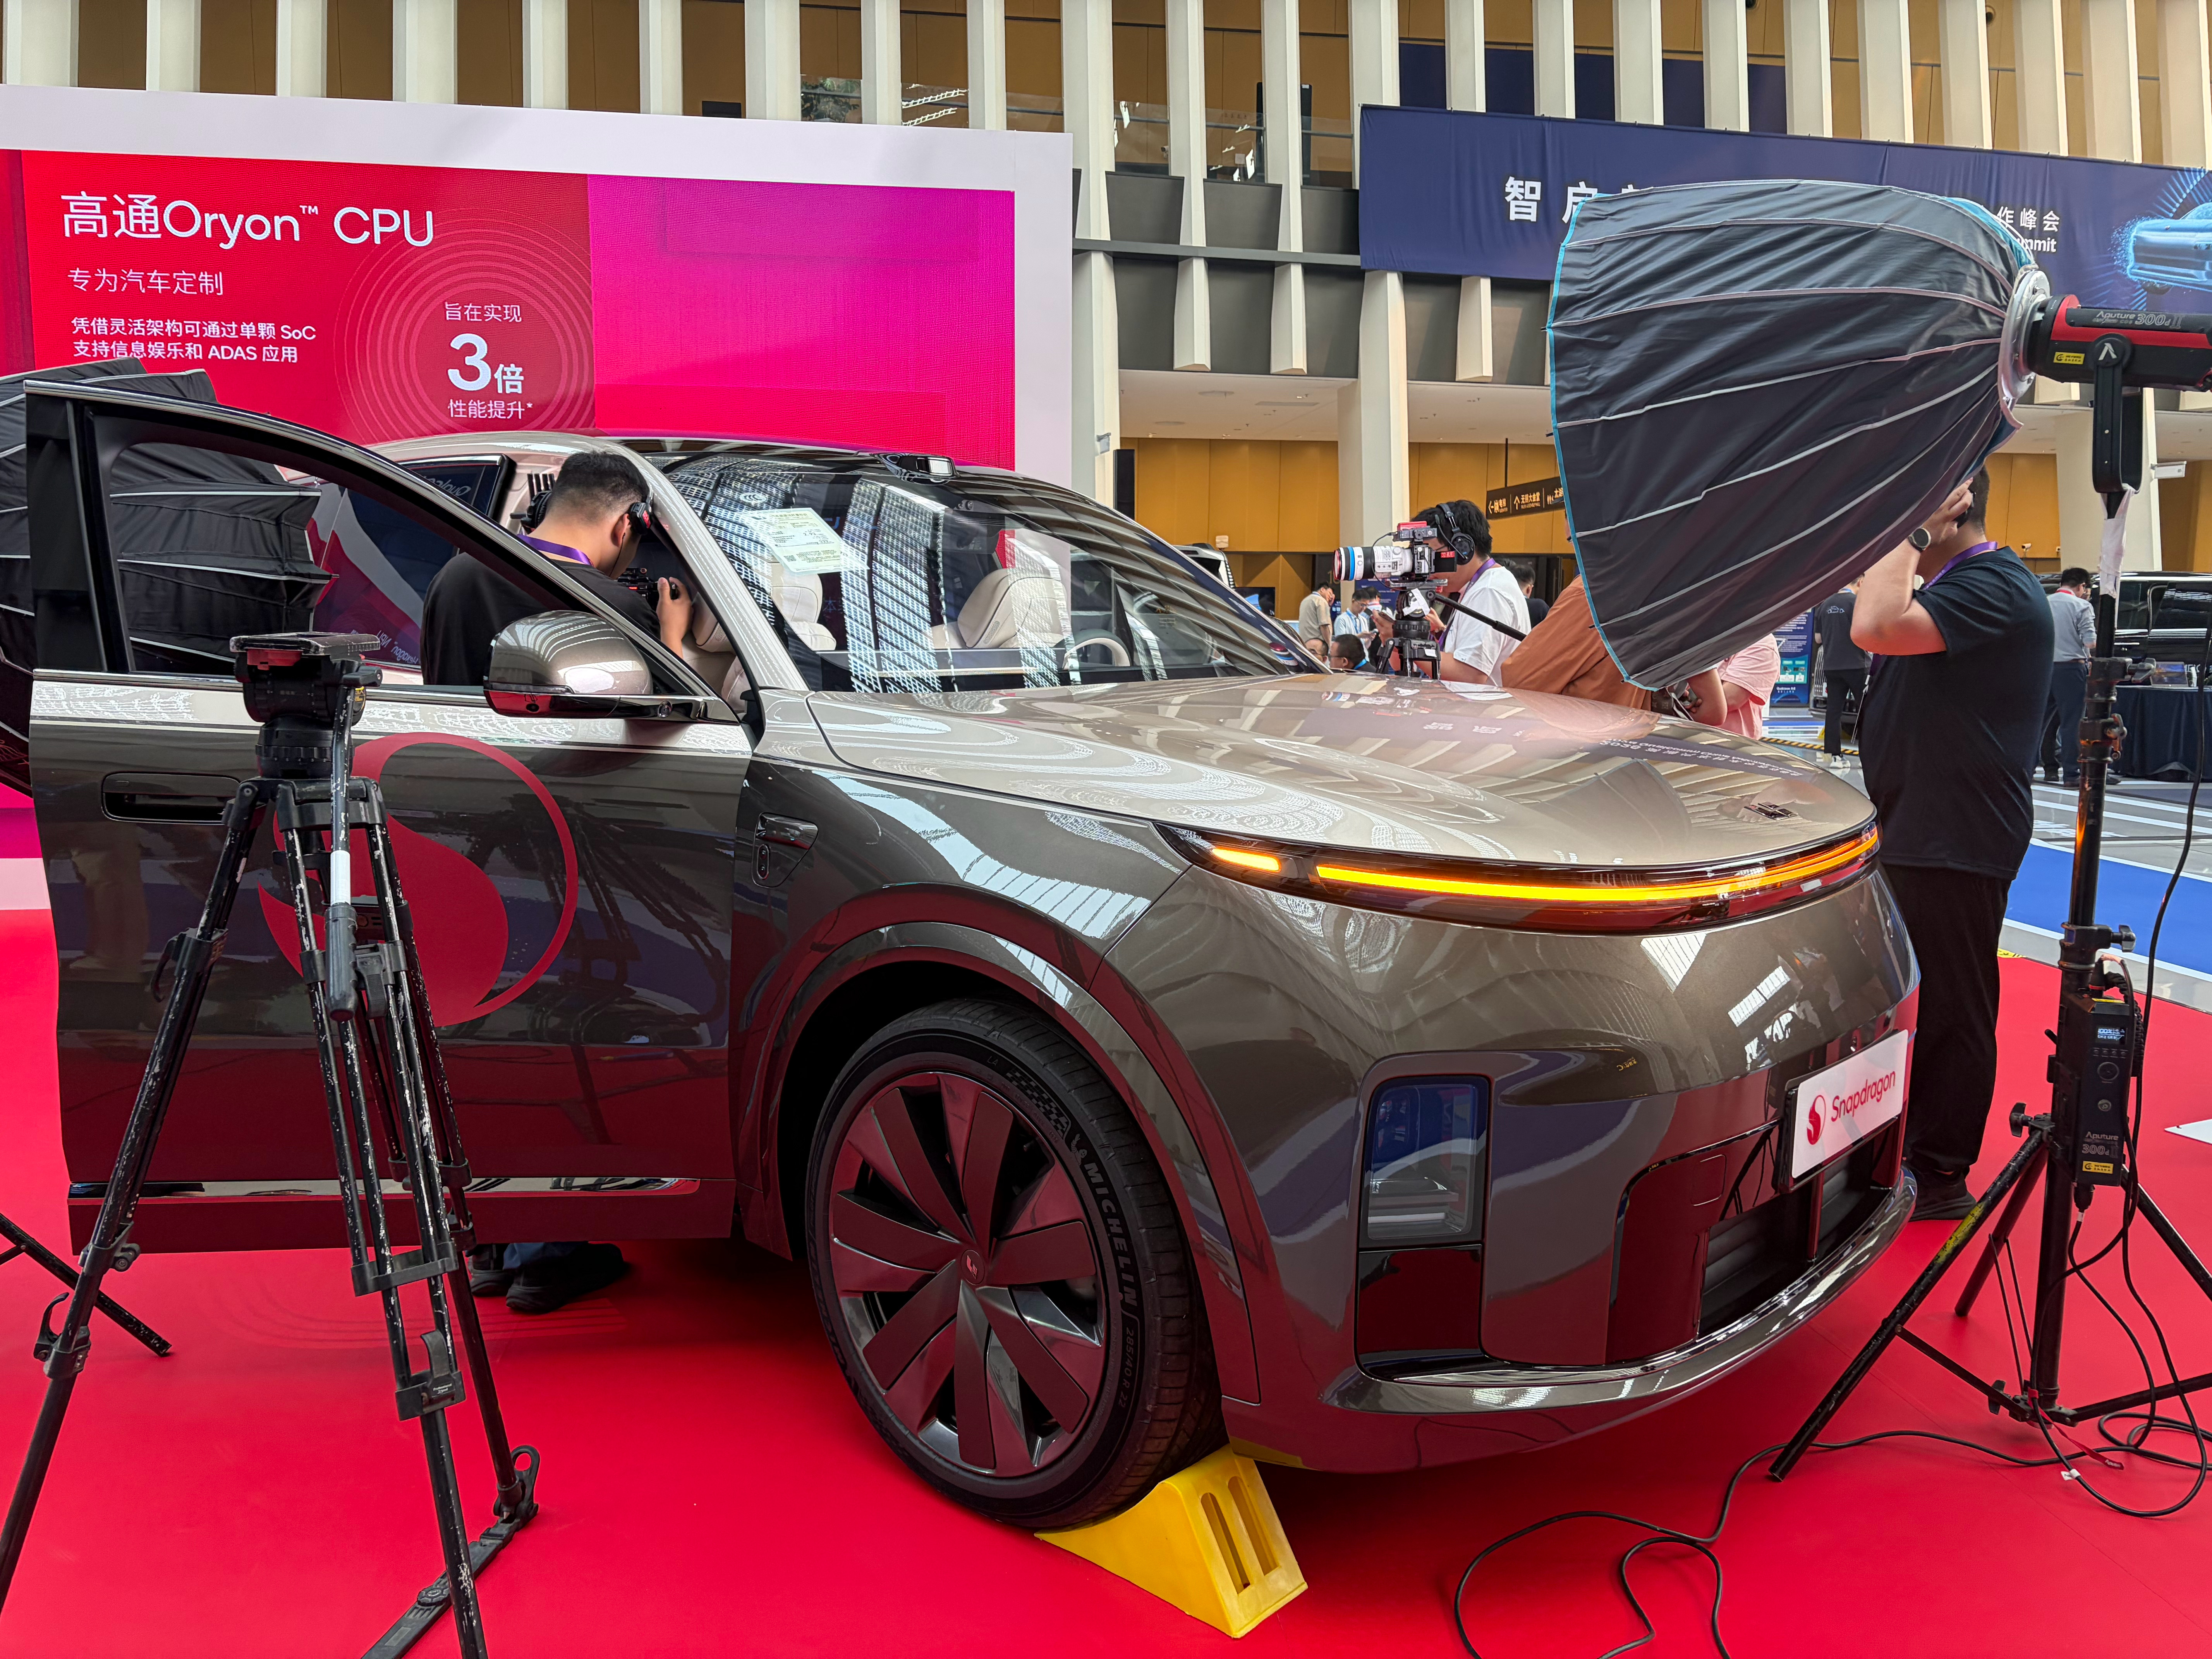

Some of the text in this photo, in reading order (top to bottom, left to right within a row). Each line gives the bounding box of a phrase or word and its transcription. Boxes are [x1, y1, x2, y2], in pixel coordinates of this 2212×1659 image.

[333, 206, 434, 247] CPU
[68, 268, 223, 295] 专为汽车定制
[444, 301, 522, 322] 旨在实现
[2096, 311, 2136, 319] Aputure
[71, 317, 316, 340] 凭借灵活架构可通过单颗 SoC
[73, 339, 298, 363] 支持信息娱乐和 ADAS 应用
[447, 333, 524, 394] 3倍
[987, 1056, 999, 1066] LA
[1831, 1071, 1896, 1122] Snapdragon
[2085, 1131, 2119, 1140] Aputure
[1084, 1162, 1137, 1307] MICHELIN
[1118, 1326, 1135, 1408] 285/40 R 22
